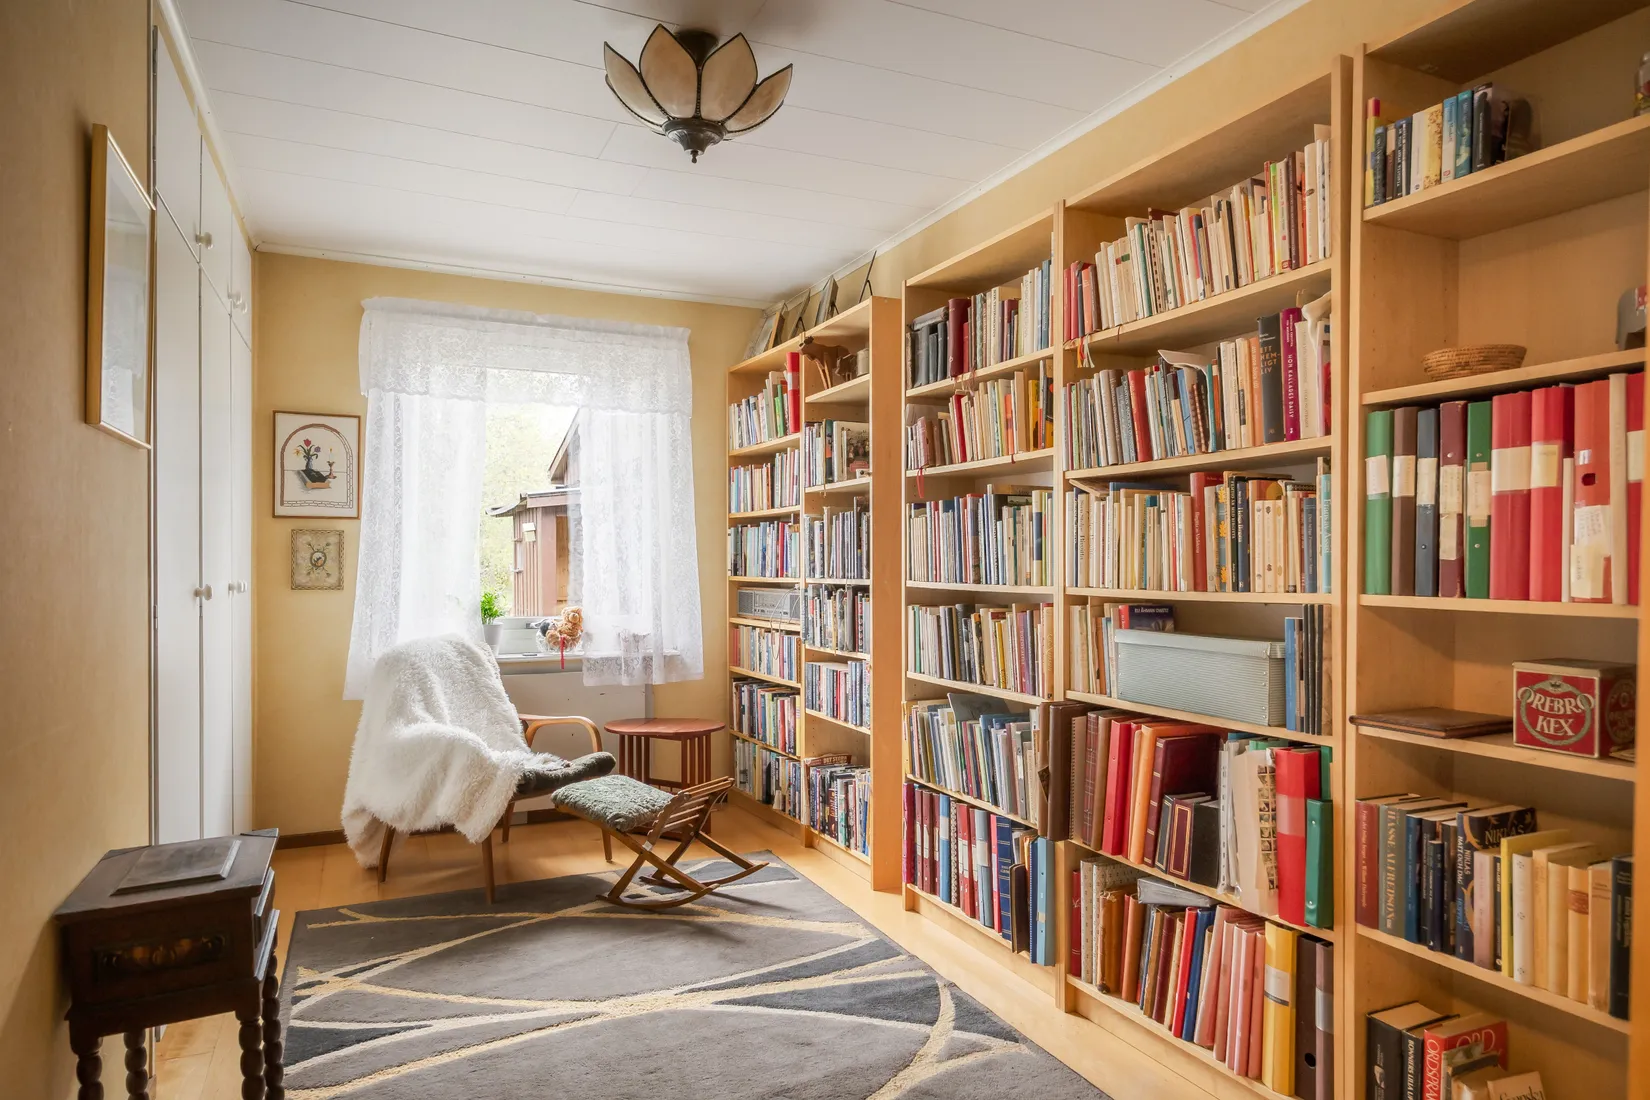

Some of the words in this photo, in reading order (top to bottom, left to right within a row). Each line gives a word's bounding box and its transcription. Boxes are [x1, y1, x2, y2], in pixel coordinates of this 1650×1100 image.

[1535, 715, 1575, 736] KEX
[1387, 810, 1396, 849] HASSE
[1386, 852, 1397, 920] ALFREDSON
[1407, 1039, 1415, 1073] BONNIERS
